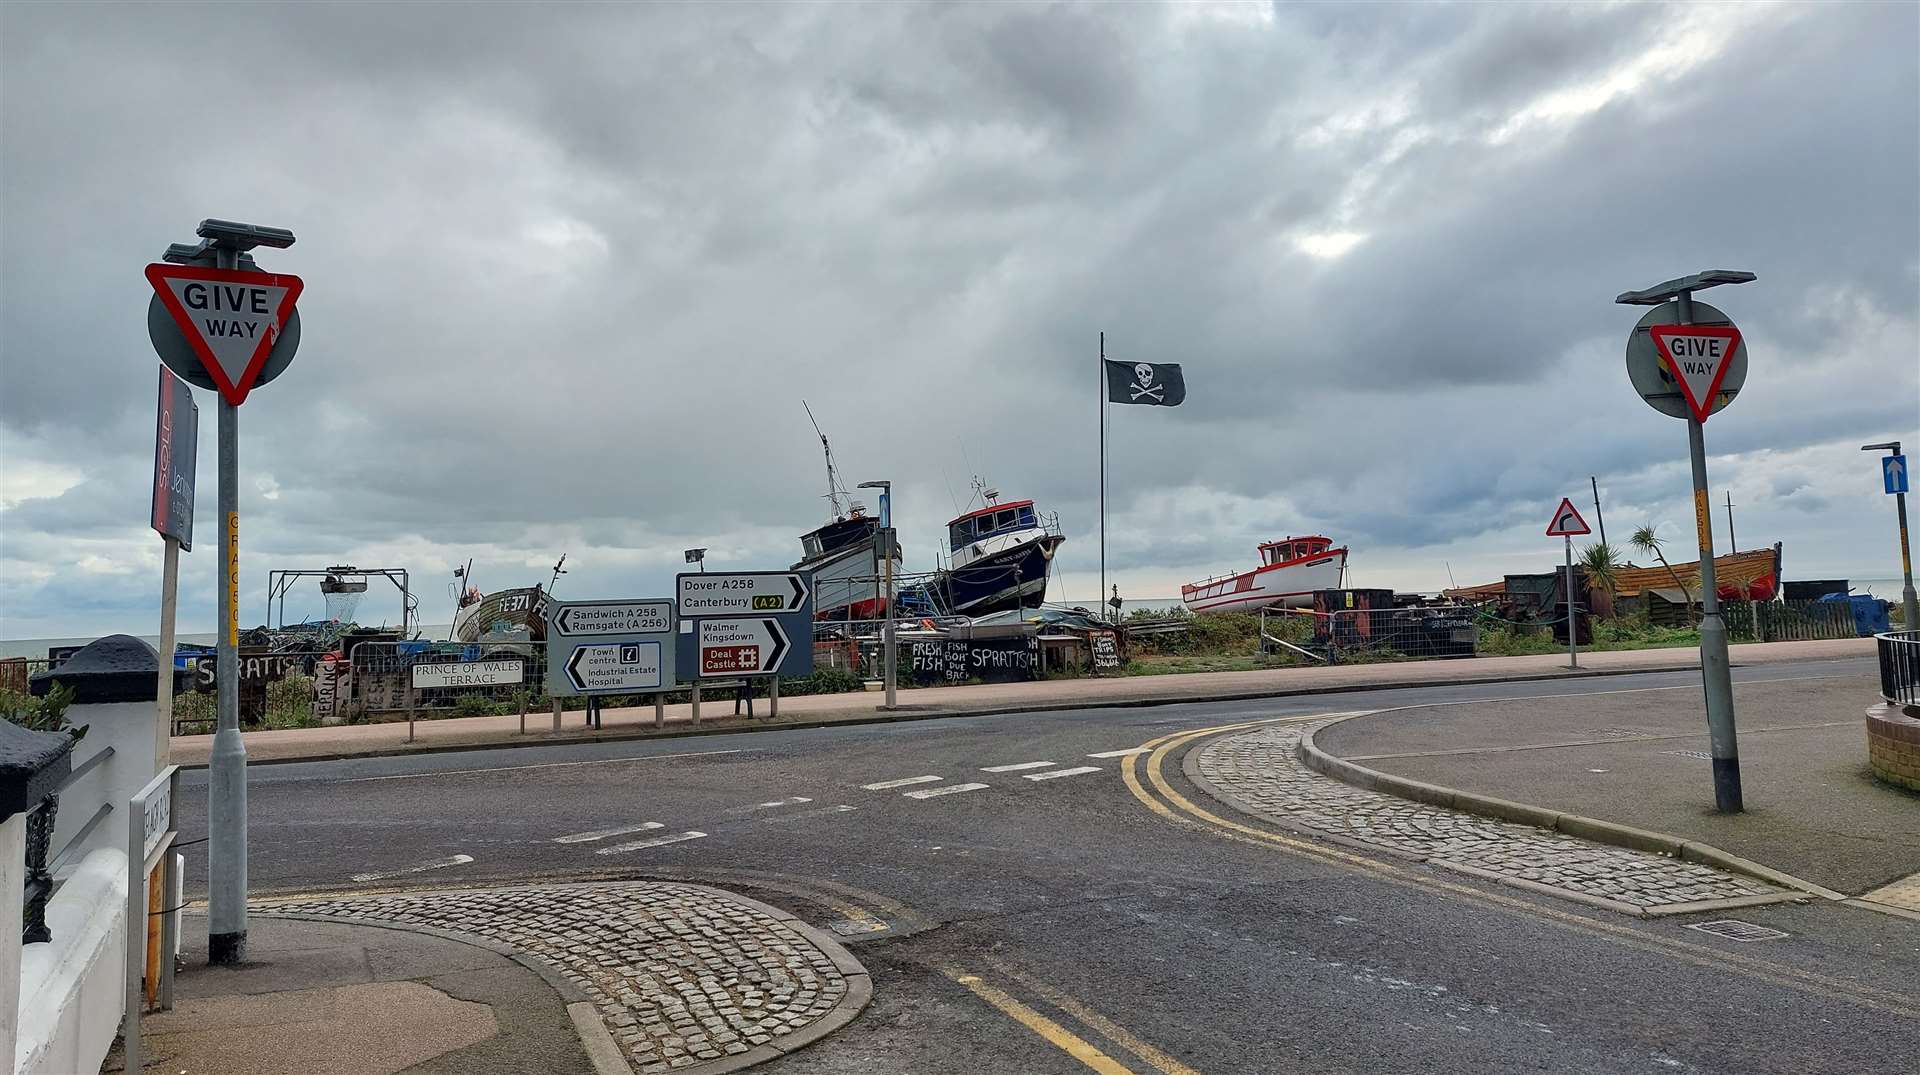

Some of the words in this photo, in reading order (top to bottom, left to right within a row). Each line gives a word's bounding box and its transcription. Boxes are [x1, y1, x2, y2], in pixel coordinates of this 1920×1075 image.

[183, 283, 269, 314] GIVE
[206, 319, 258, 339] WAY
[1671, 338, 1720, 357] GIVE
[1684, 362, 1713, 375] WAY
[159, 410, 172, 488] SOLD
[684, 581, 717, 590] Dover
[684, 597, 748, 608] Canterbury
[753, 597, 783, 608] (A2)
[573, 609, 624, 619] Sandwich
[573, 620, 624, 631] Ramsgate
[703, 623, 739, 632] Walmer
[703, 633, 754, 643] Kingsdown
[912, 642, 942, 656] FRESH
[947, 642, 967, 651] FISH
[592, 648, 614, 656] Town
[710, 650, 732, 659] Deal
[416, 664, 458, 675] PRINCE
[463, 663, 477, 673] OF
[484, 662, 520, 672] WALES
[706, 660, 736, 669] Castle
[912, 657, 942, 671] FISH
[949, 662, 966, 671] DUE
[588, 667, 627, 677] Industrial
[442, 674, 496, 685] TERRACE
[588, 678, 623, 687] Hospital
